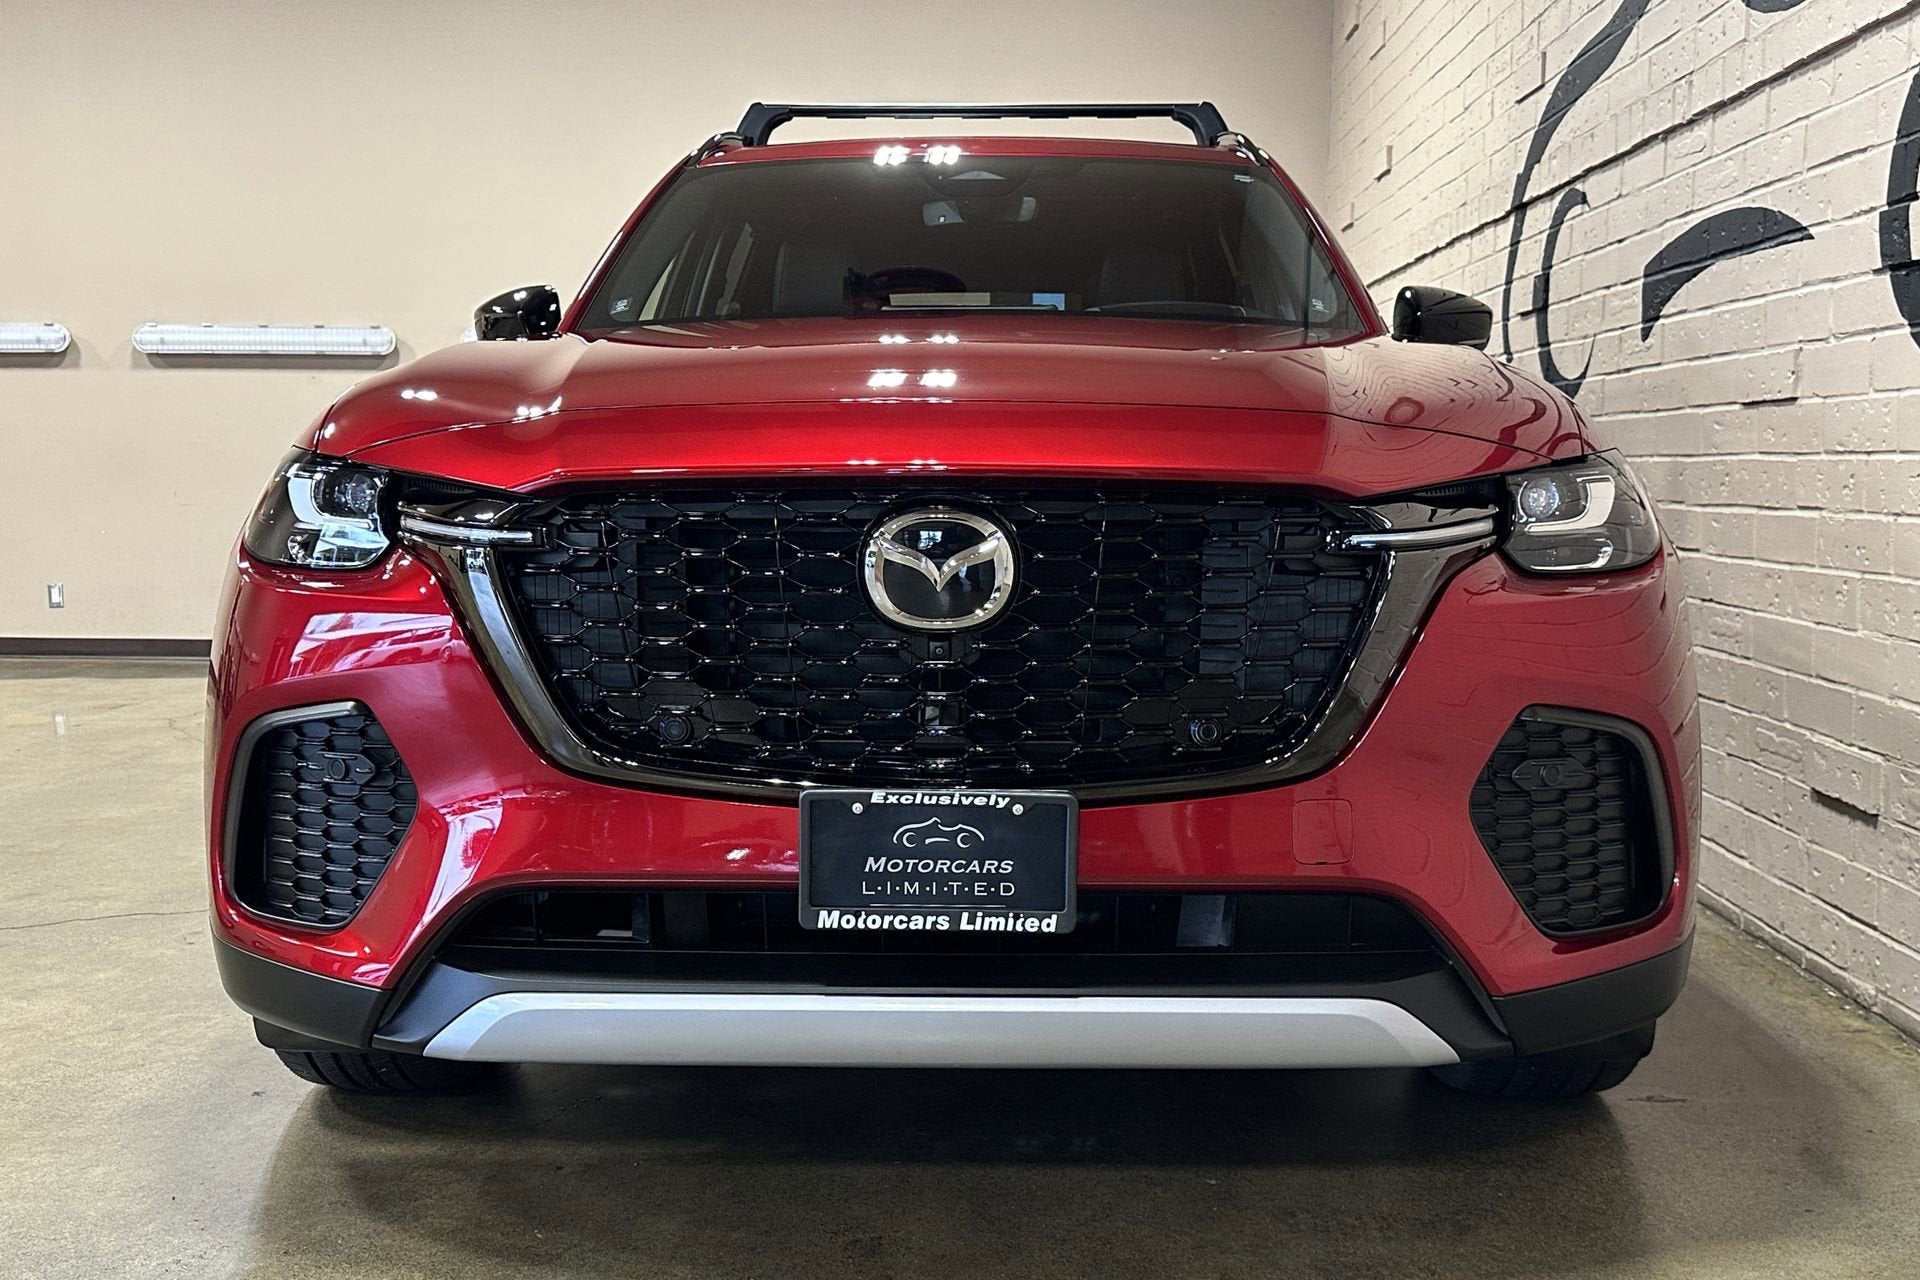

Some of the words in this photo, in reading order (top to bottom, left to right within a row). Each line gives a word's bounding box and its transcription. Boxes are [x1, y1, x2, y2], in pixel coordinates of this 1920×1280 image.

[870, 791, 1011, 808] Exclusively
[864, 856, 1014, 874] MOTORCARS
[817, 910, 950, 930] Motorcars
[960, 911, 1058, 933] Limited
